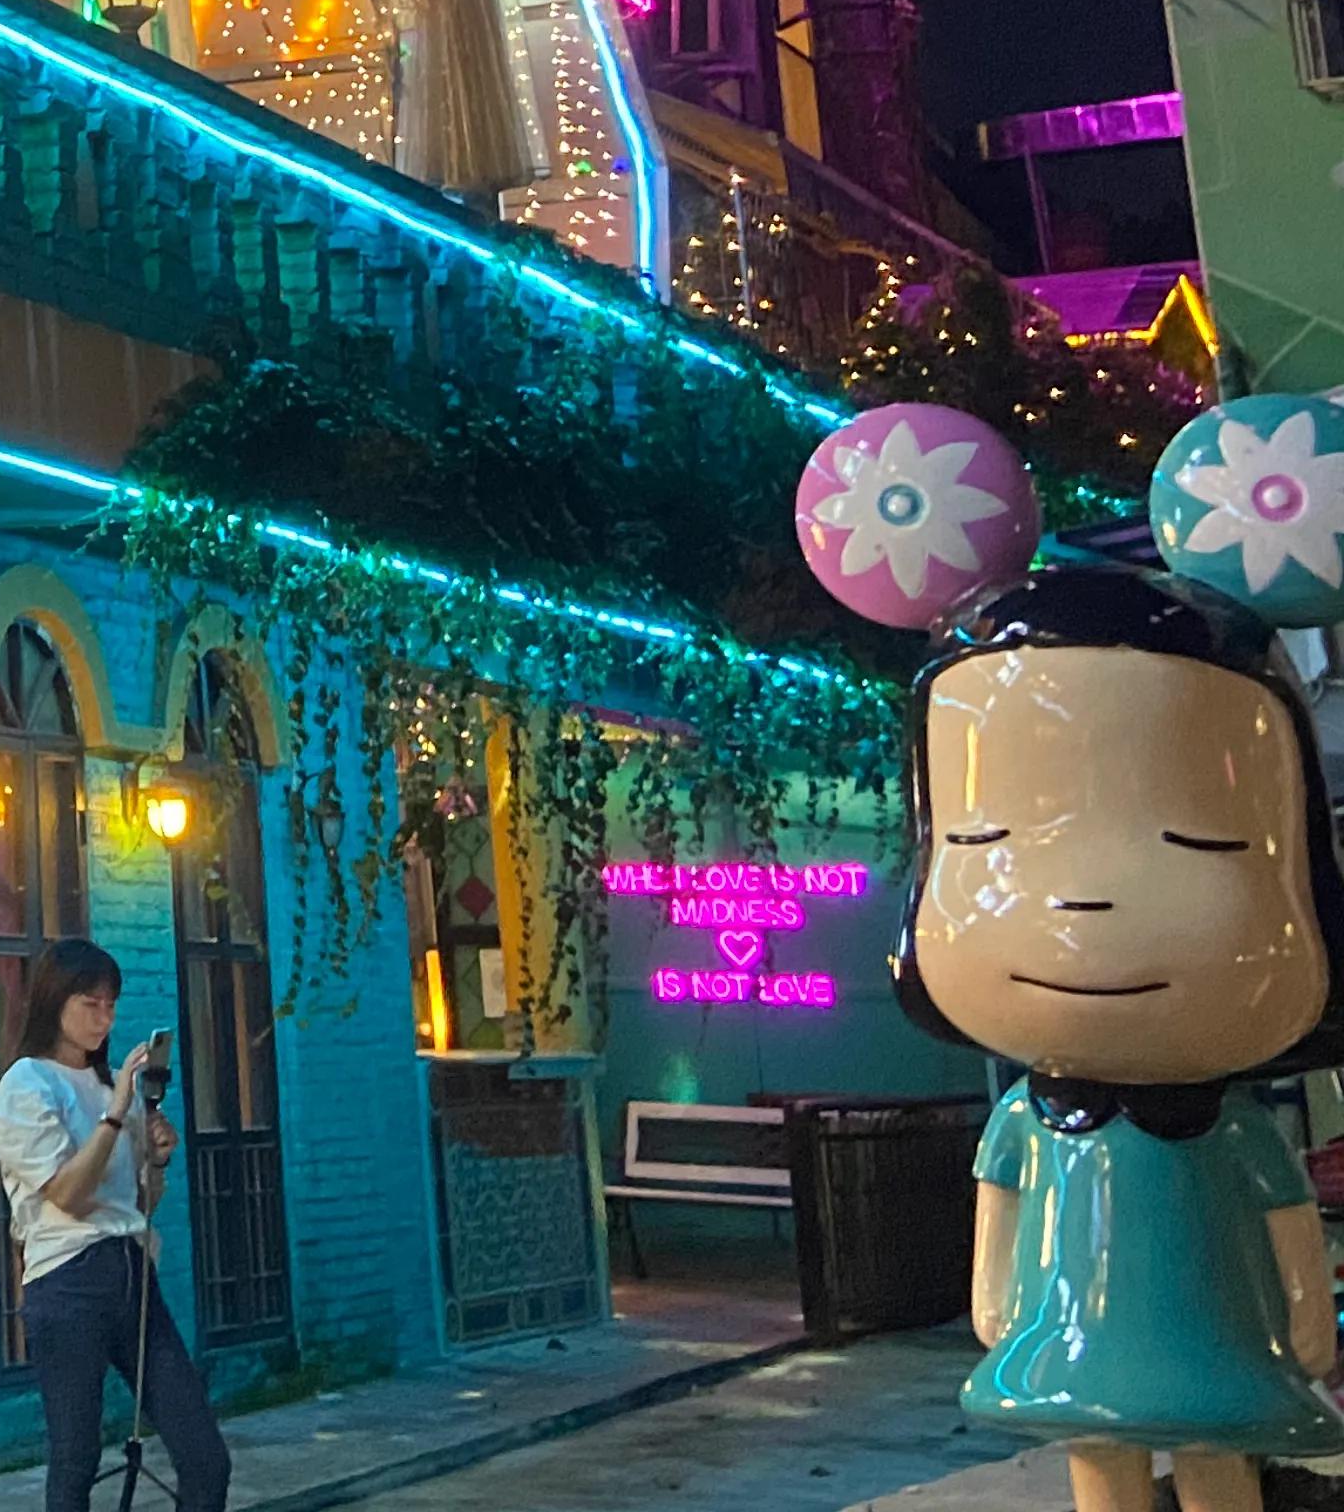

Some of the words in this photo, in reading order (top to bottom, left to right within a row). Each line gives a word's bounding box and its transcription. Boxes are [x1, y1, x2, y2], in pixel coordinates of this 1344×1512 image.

[690, 865, 762, 892] LOVE
[768, 865, 796, 892] IS
[803, 864, 867, 895] NOT
[671, 898, 800, 926] MADNESS
[655, 970, 682, 998] IS
[691, 972, 750, 1001] NOT
[758, 974, 834, 1003] LOVE
